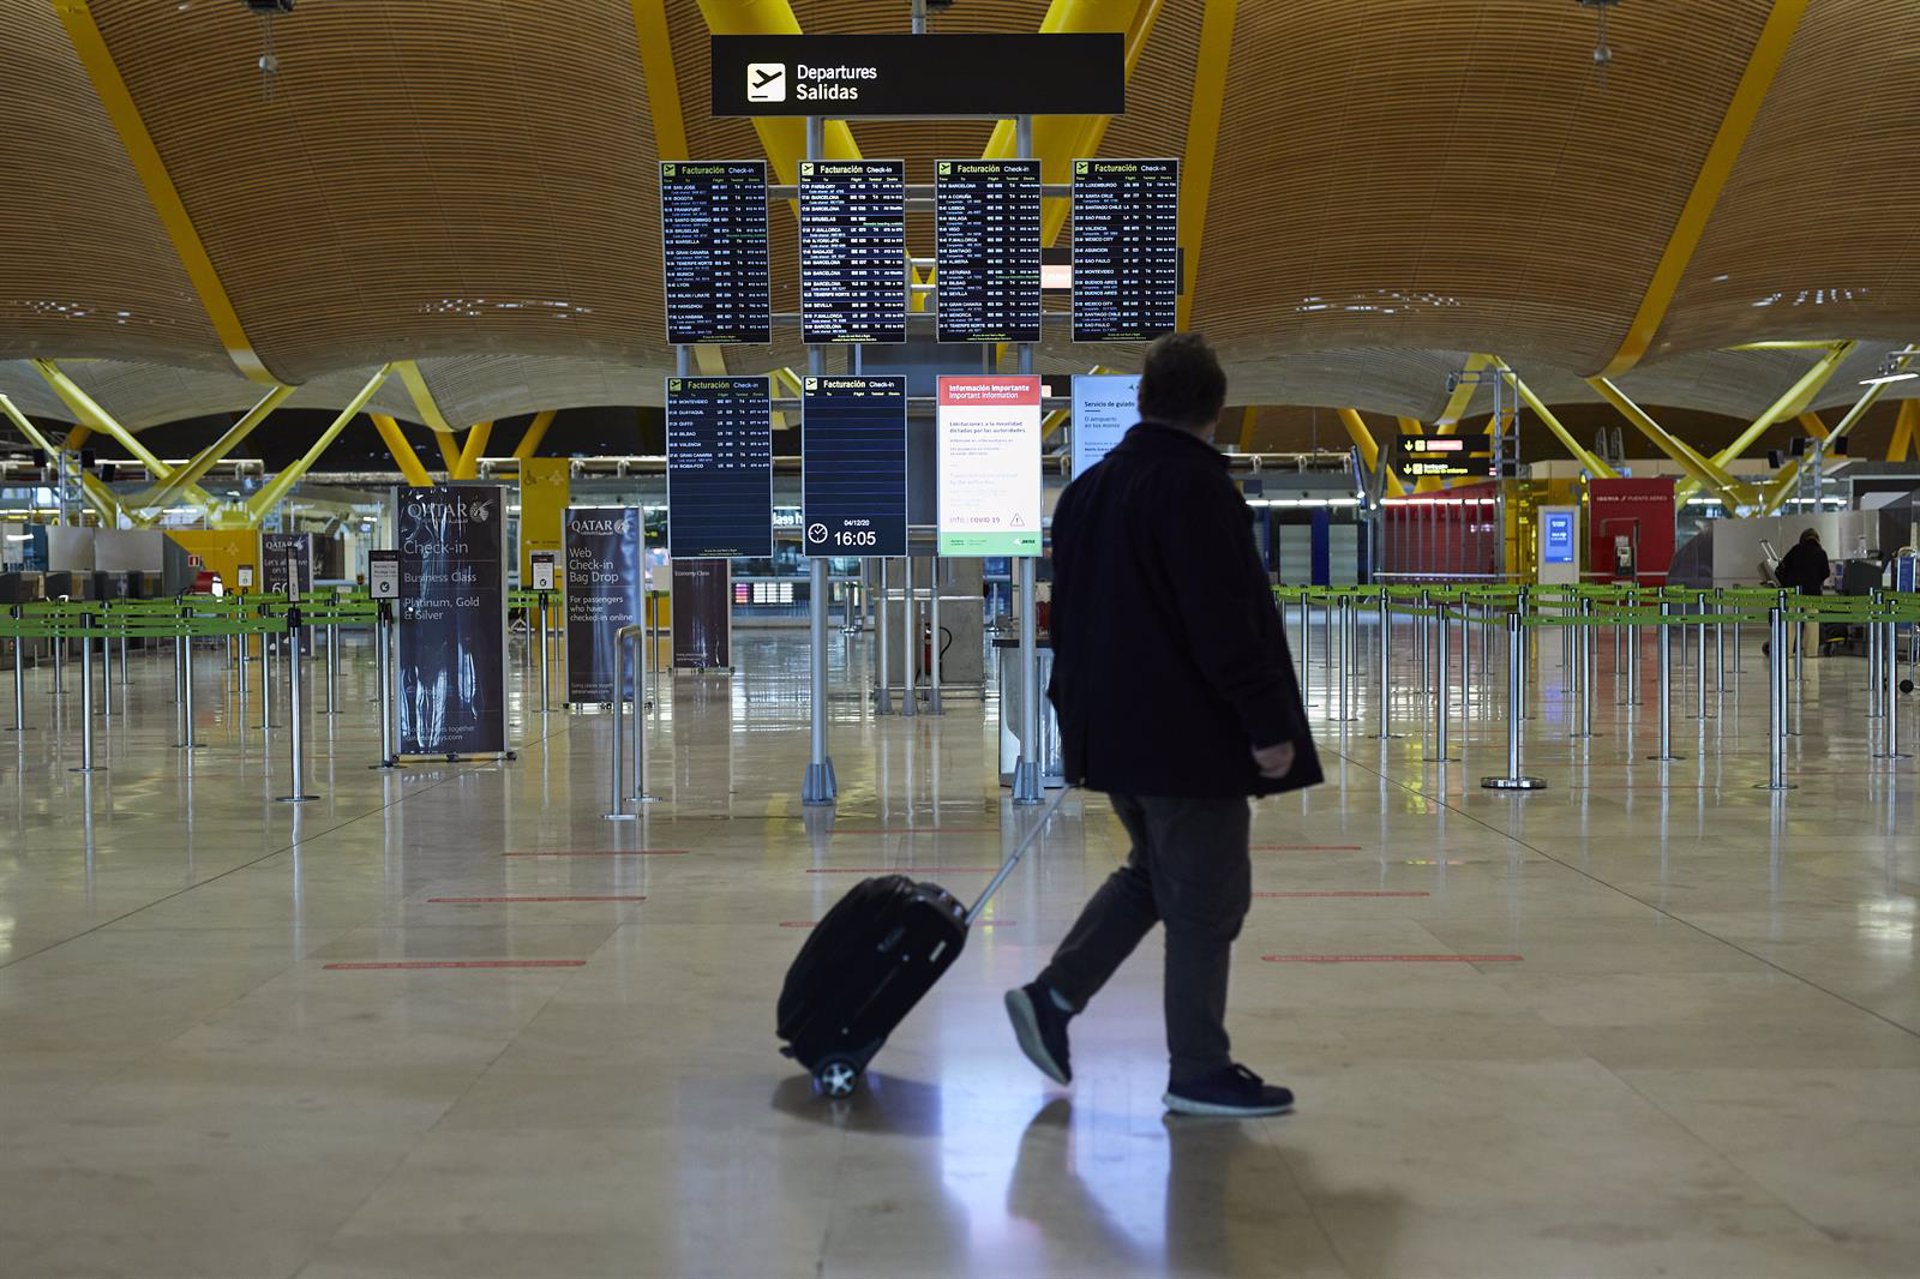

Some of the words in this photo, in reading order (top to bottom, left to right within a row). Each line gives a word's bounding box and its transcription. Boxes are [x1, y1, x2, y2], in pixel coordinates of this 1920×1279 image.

[798, 64, 877, 82] Departures
[796, 84, 858, 100] Salidas
[682, 166, 724, 174] Facturación
[820, 165, 863, 174] Facturación
[823, 380, 866, 388] Facturación
[408, 503, 467, 521] QATAR
[571, 520, 612, 532] QATAR
[834, 531, 876, 546] 16:05
[404, 540, 468, 554] Check-in
[569, 548, 592, 557] Web
[570, 559, 613, 570] Check-in
[404, 572, 448, 583] Business
[451, 572, 476, 583] Class
[570, 572, 588, 584] Bag
[592, 572, 619, 584] Drop
[404, 597, 453, 608] Platinum,
[456, 597, 479, 607] Gold
[583, 596, 623, 604] passengers
[404, 611, 412, 620] &
[416, 611, 444, 620] Silver
